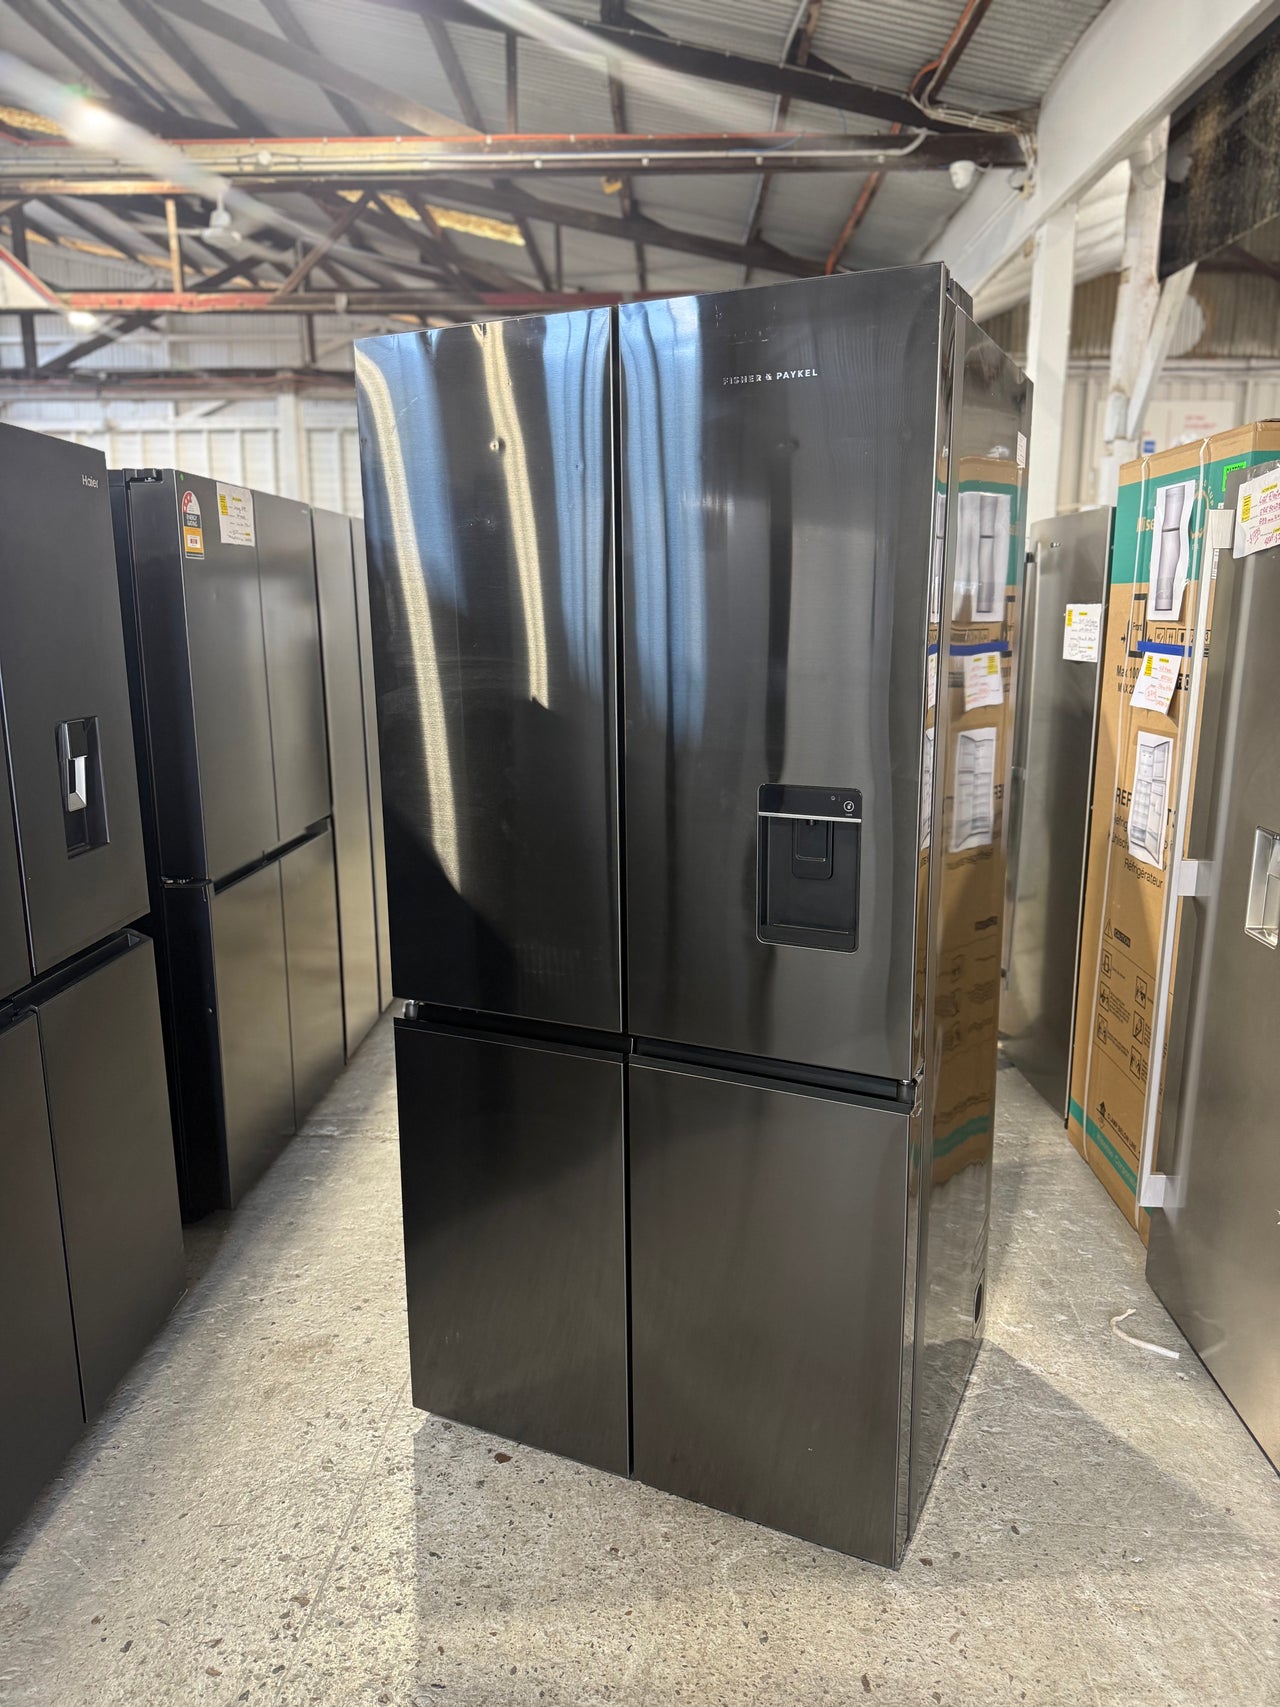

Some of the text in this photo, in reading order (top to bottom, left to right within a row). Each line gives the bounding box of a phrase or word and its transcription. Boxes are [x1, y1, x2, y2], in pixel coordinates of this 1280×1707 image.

[722, 368, 818, 386] FISHER & PAYKEL
[81, 473, 99, 489] Haier
[1124, 858, 1163, 888] Réfrigérateur
